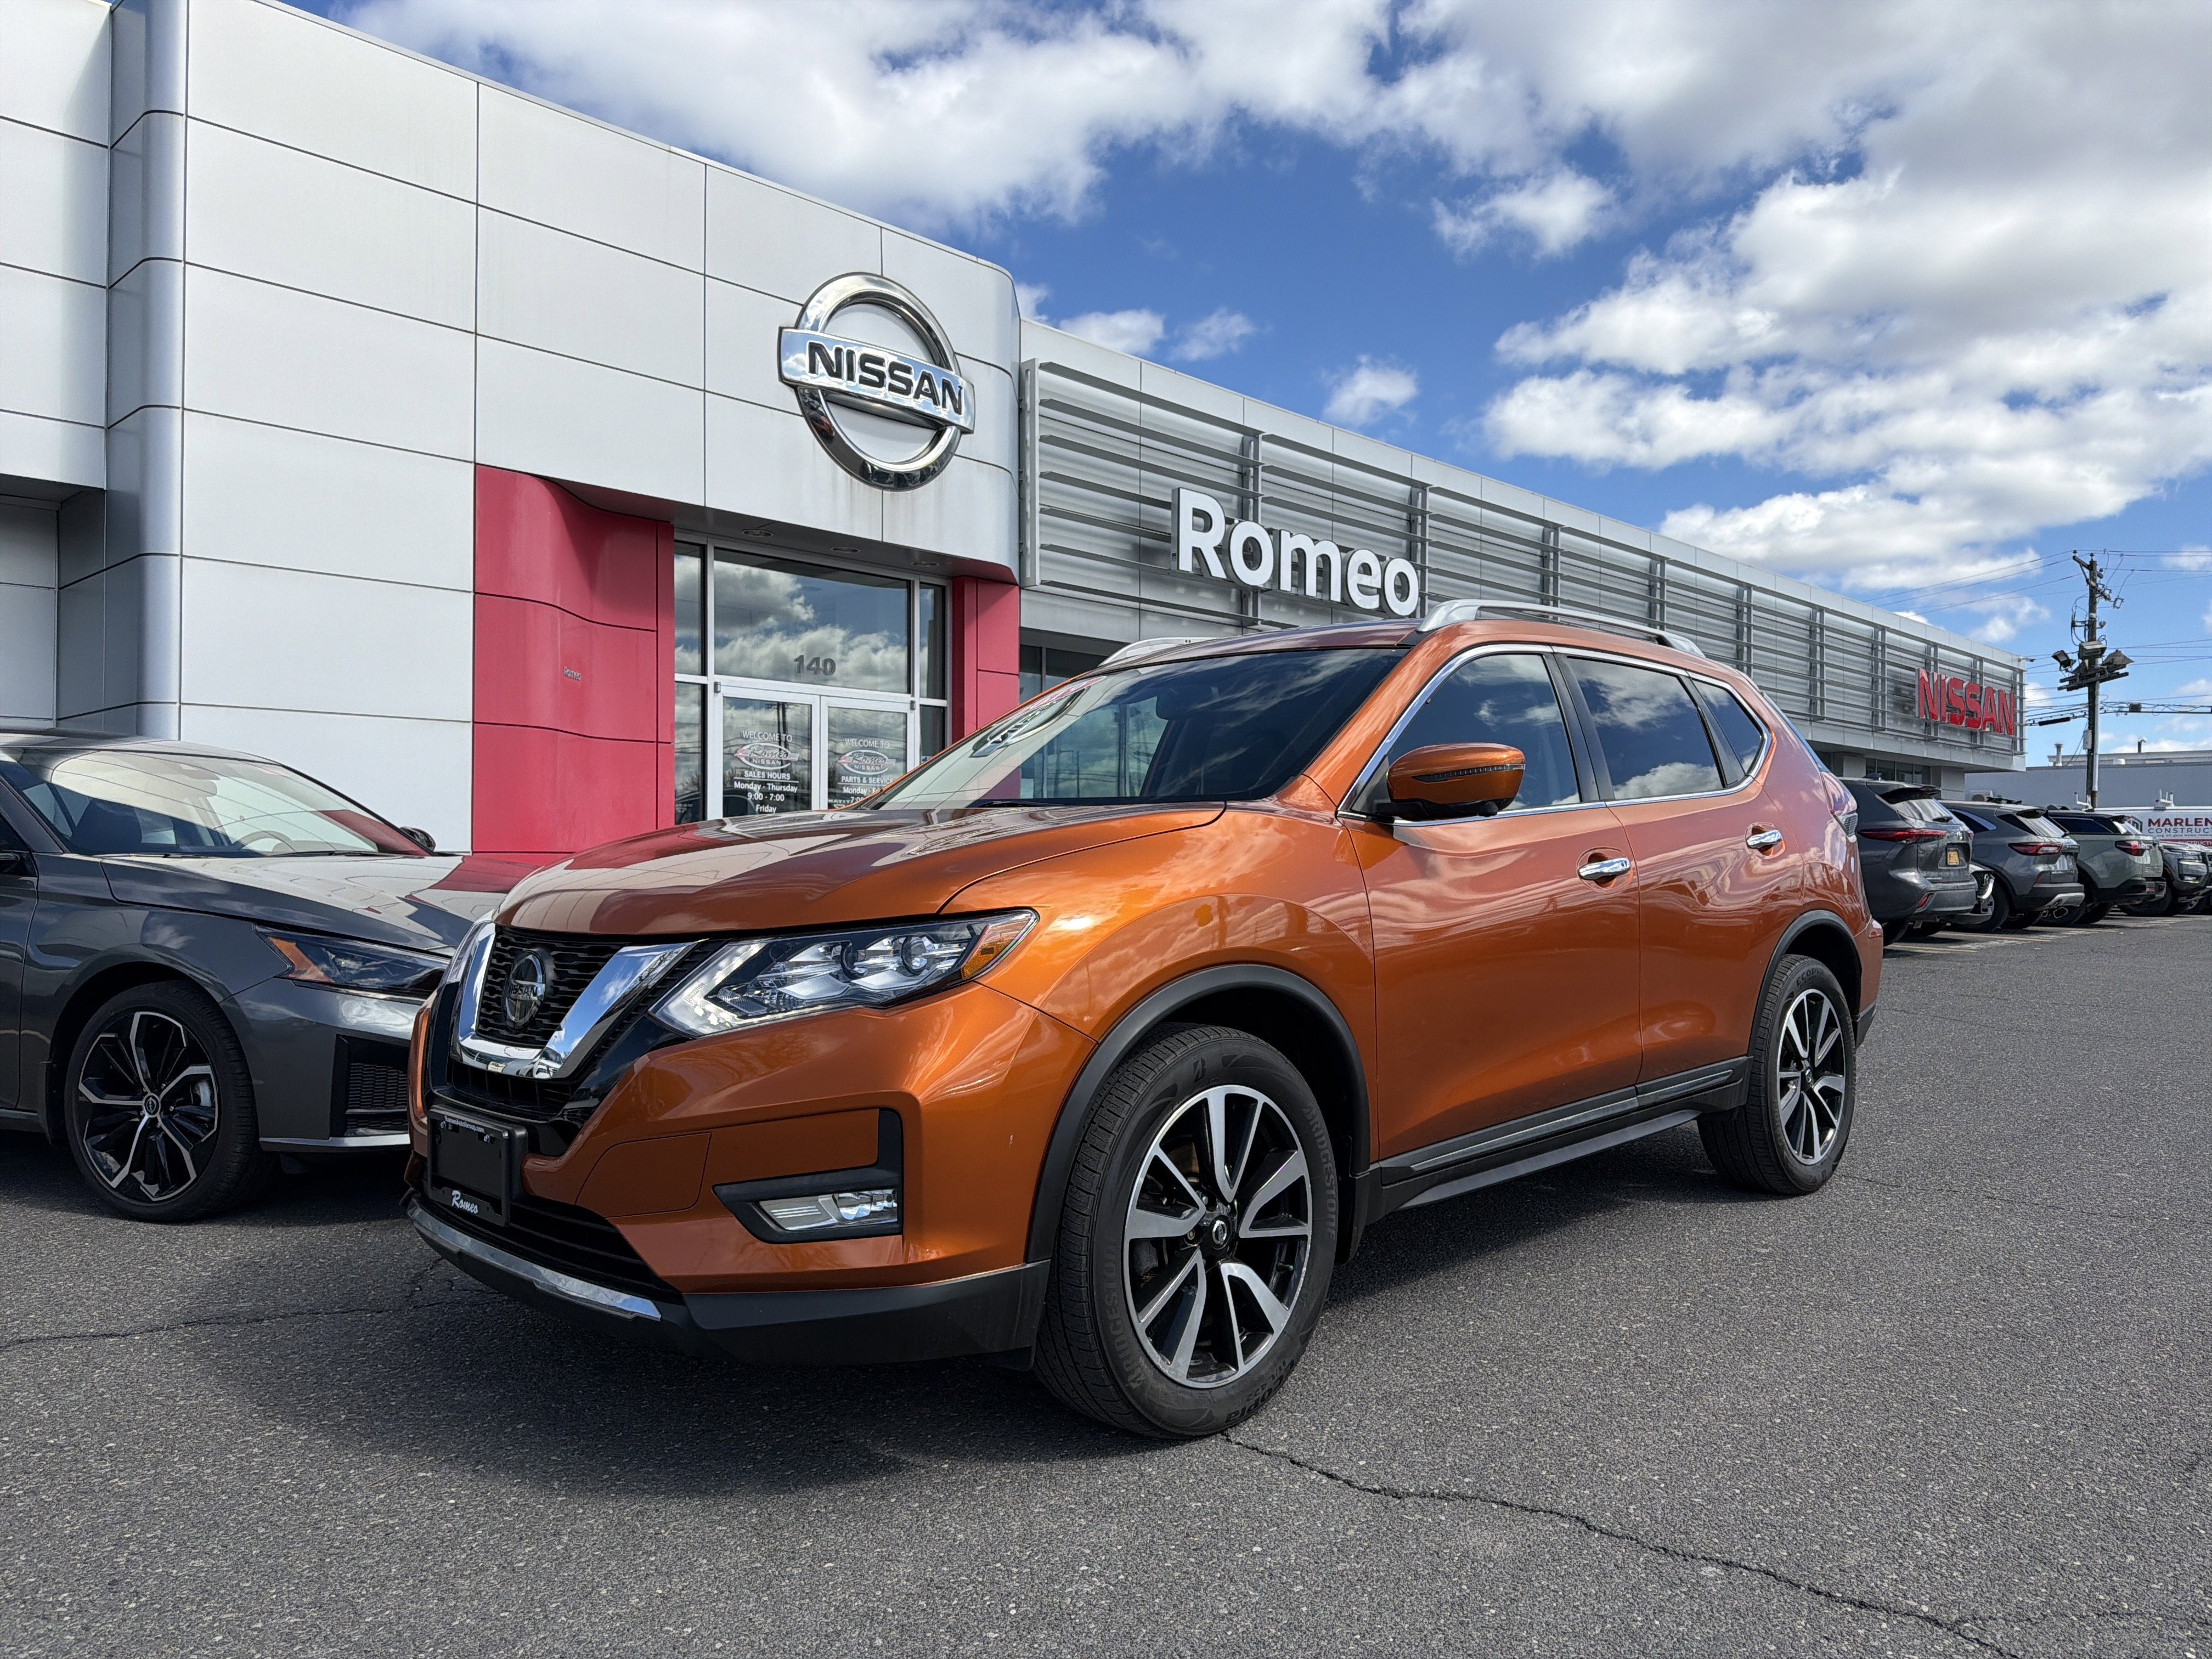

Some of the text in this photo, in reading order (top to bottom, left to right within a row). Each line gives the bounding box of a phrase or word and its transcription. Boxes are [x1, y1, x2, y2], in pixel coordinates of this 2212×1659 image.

[807, 341, 964, 415] NISSAN
[1172, 487, 1419, 617] Romeo
[793, 654, 837, 676] 140
[1916, 668, 2015, 736] NISSAN
[742, 730, 793, 742] WELCOME TO
[844, 738, 890, 749] WELCOME TO
[749, 744, 789, 759] Romeo
[851, 751, 887, 764] Romeo
[744, 770, 791, 780] SALES HOURS
[841, 775, 861, 783] PARTS
[868, 776, 894, 785] SERVICE
[733, 781, 761, 792] Monday
[767, 782, 798, 793] Thursday
[843, 786, 867, 795] Monday
[747, 792, 763, 801] 9:00
[769, 793, 785, 802] 7:00
[755, 804, 777, 814] Friday
[2148, 817, 2212, 827] MARLEN
[452, 1190, 479, 1214] Romeo
